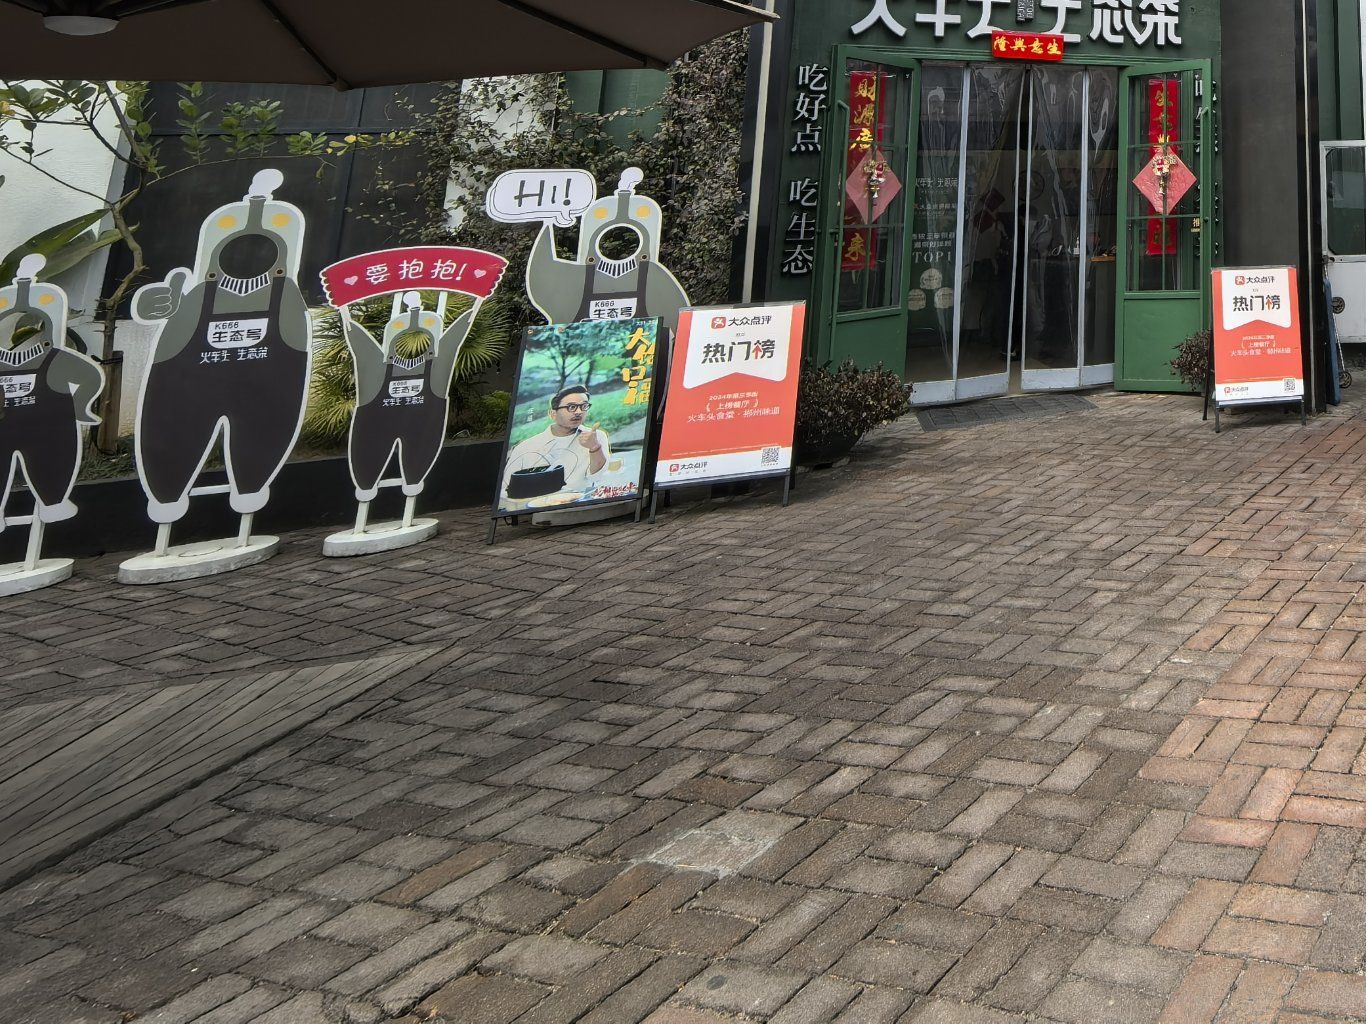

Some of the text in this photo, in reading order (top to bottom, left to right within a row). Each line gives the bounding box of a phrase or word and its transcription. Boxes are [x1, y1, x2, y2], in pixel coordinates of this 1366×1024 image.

[782, 63, 828, 274] 吃好点 吃生态
[514, 178, 571, 207] Hi!
[1246, 276, 1274, 284] 大众点评
[1233, 295, 1280, 311] 热门榜
[593, 307, 632, 318] 生态号
[728, 316, 772, 326] 大众点评
[212, 329, 261, 343] 生态号
[200, 350, 231, 364] 火车头
[701, 339, 776, 364] 热门榜
